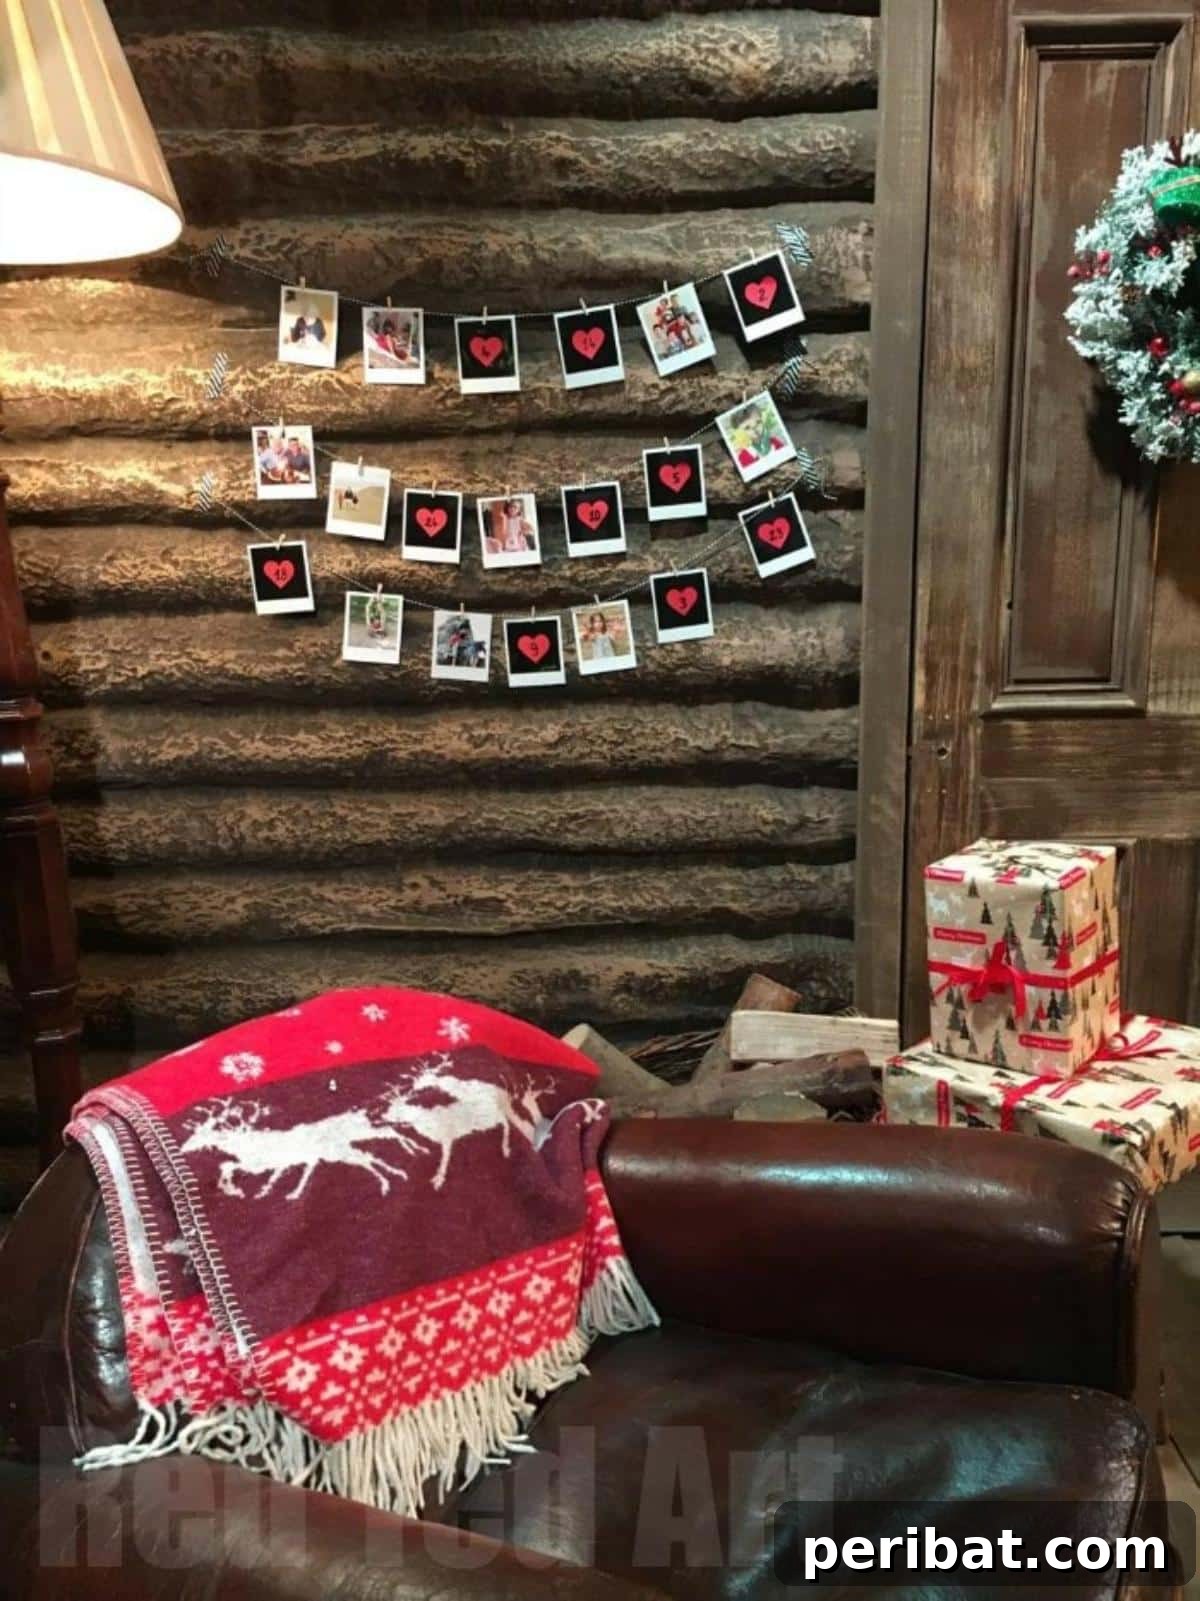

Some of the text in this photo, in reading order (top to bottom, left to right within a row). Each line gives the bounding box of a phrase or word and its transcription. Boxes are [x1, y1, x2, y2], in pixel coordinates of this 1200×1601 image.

[758, 287, 769, 302] 2
[672, 472, 681, 483] 5
[589, 509, 601, 522] 10
